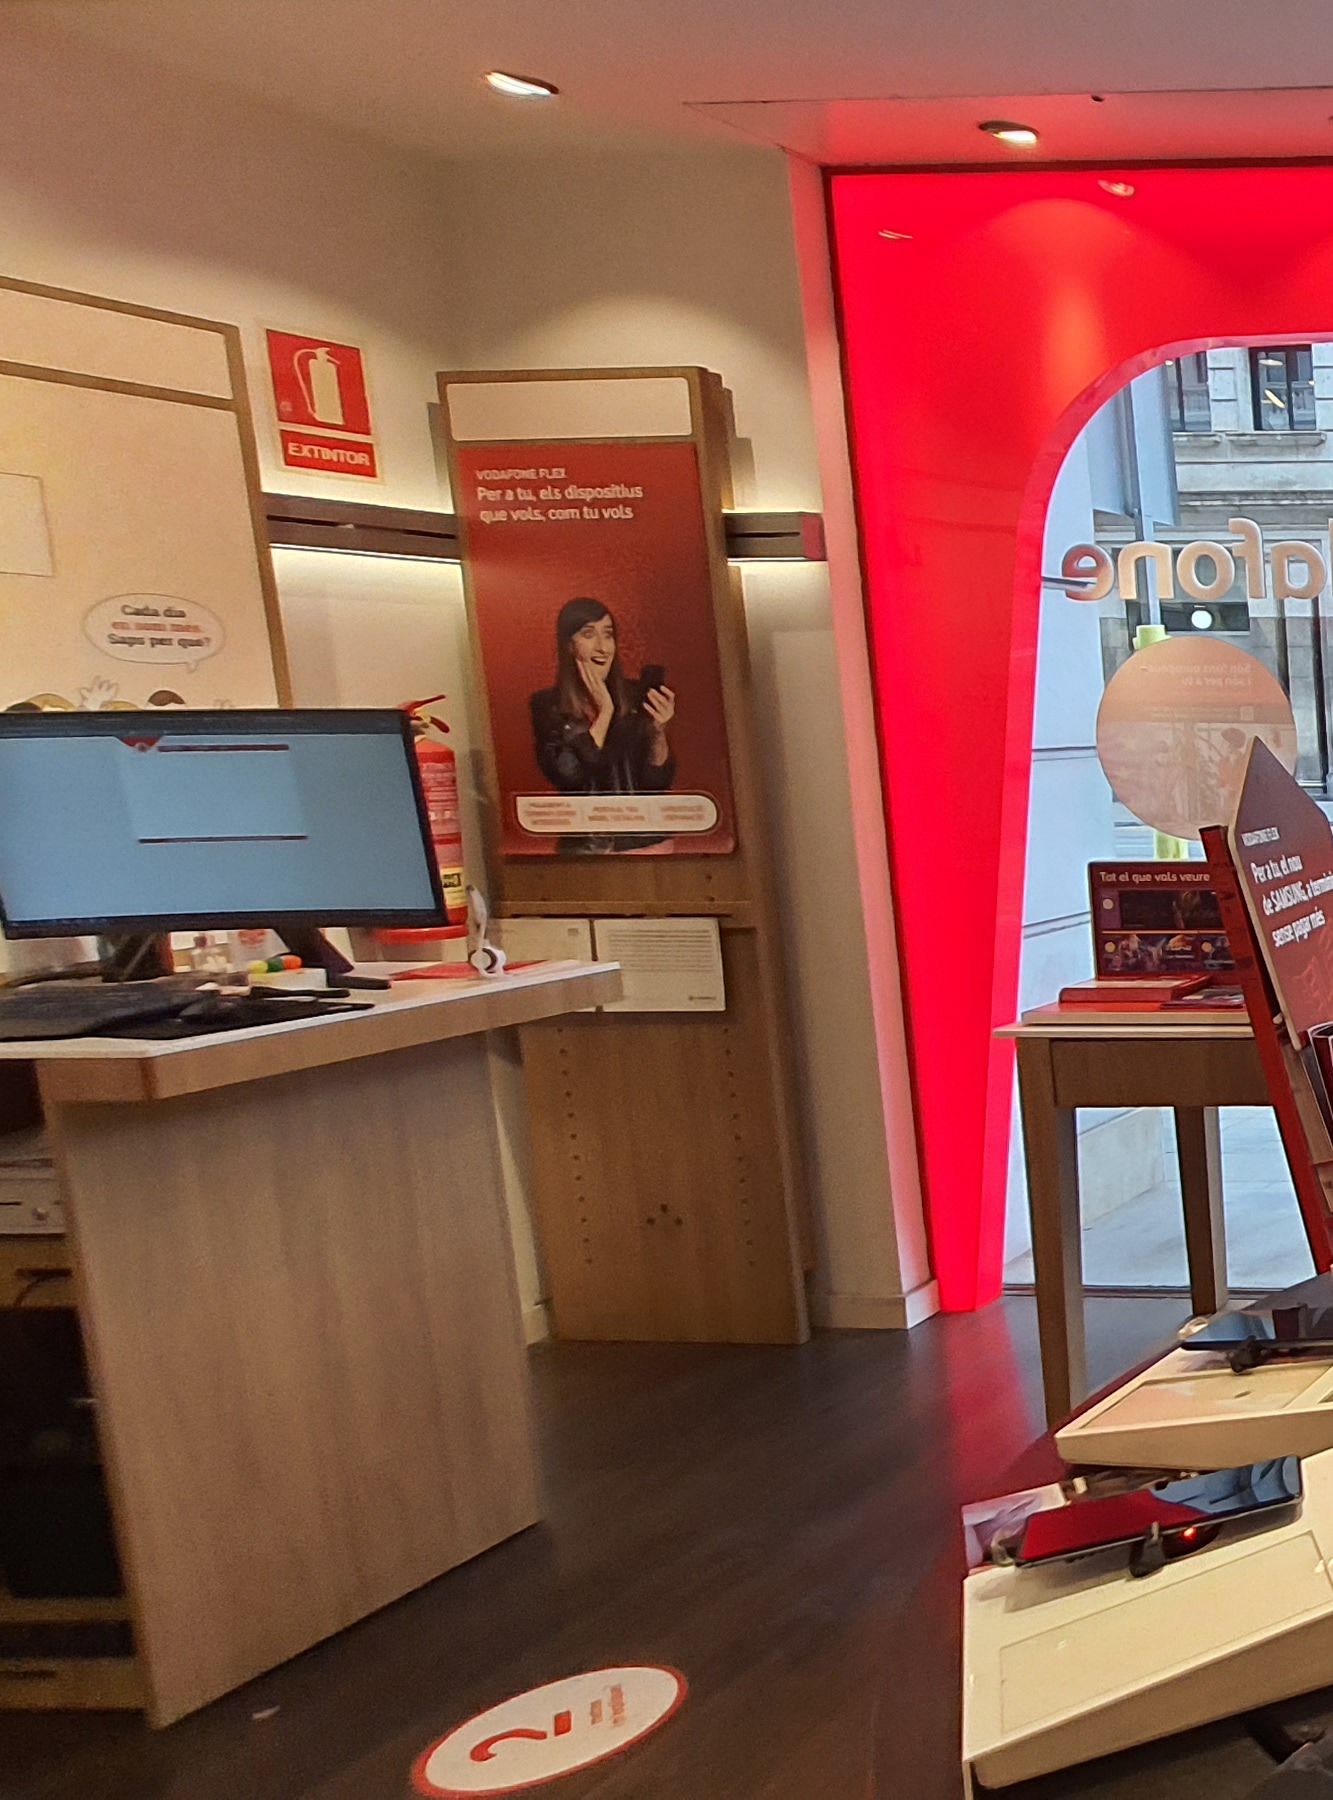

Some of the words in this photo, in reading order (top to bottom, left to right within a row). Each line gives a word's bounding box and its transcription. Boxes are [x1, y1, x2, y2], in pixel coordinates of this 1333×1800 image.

[287, 442, 370, 466] EXTINTOR
[476, 469, 537, 480] VODAFONE
[477, 487, 502, 500] Per
[505, 490, 514, 500] a
[517, 487, 537, 502] tu,
[540, 486, 563, 499] els
[565, 483, 643, 502] dispositius
[480, 510, 508, 524] que
[511, 508, 546, 521] vols,
[548, 507, 580, 519] com
[583, 506, 600, 518] tu
[602, 504, 634, 519] vols
[1099, 871, 1117, 882] Tot
[1118, 871, 1130, 882] el
[1131, 873, 1153, 884] que
[1154, 871, 1178, 882] vols
[1179, 873, 1211, 882] veure
